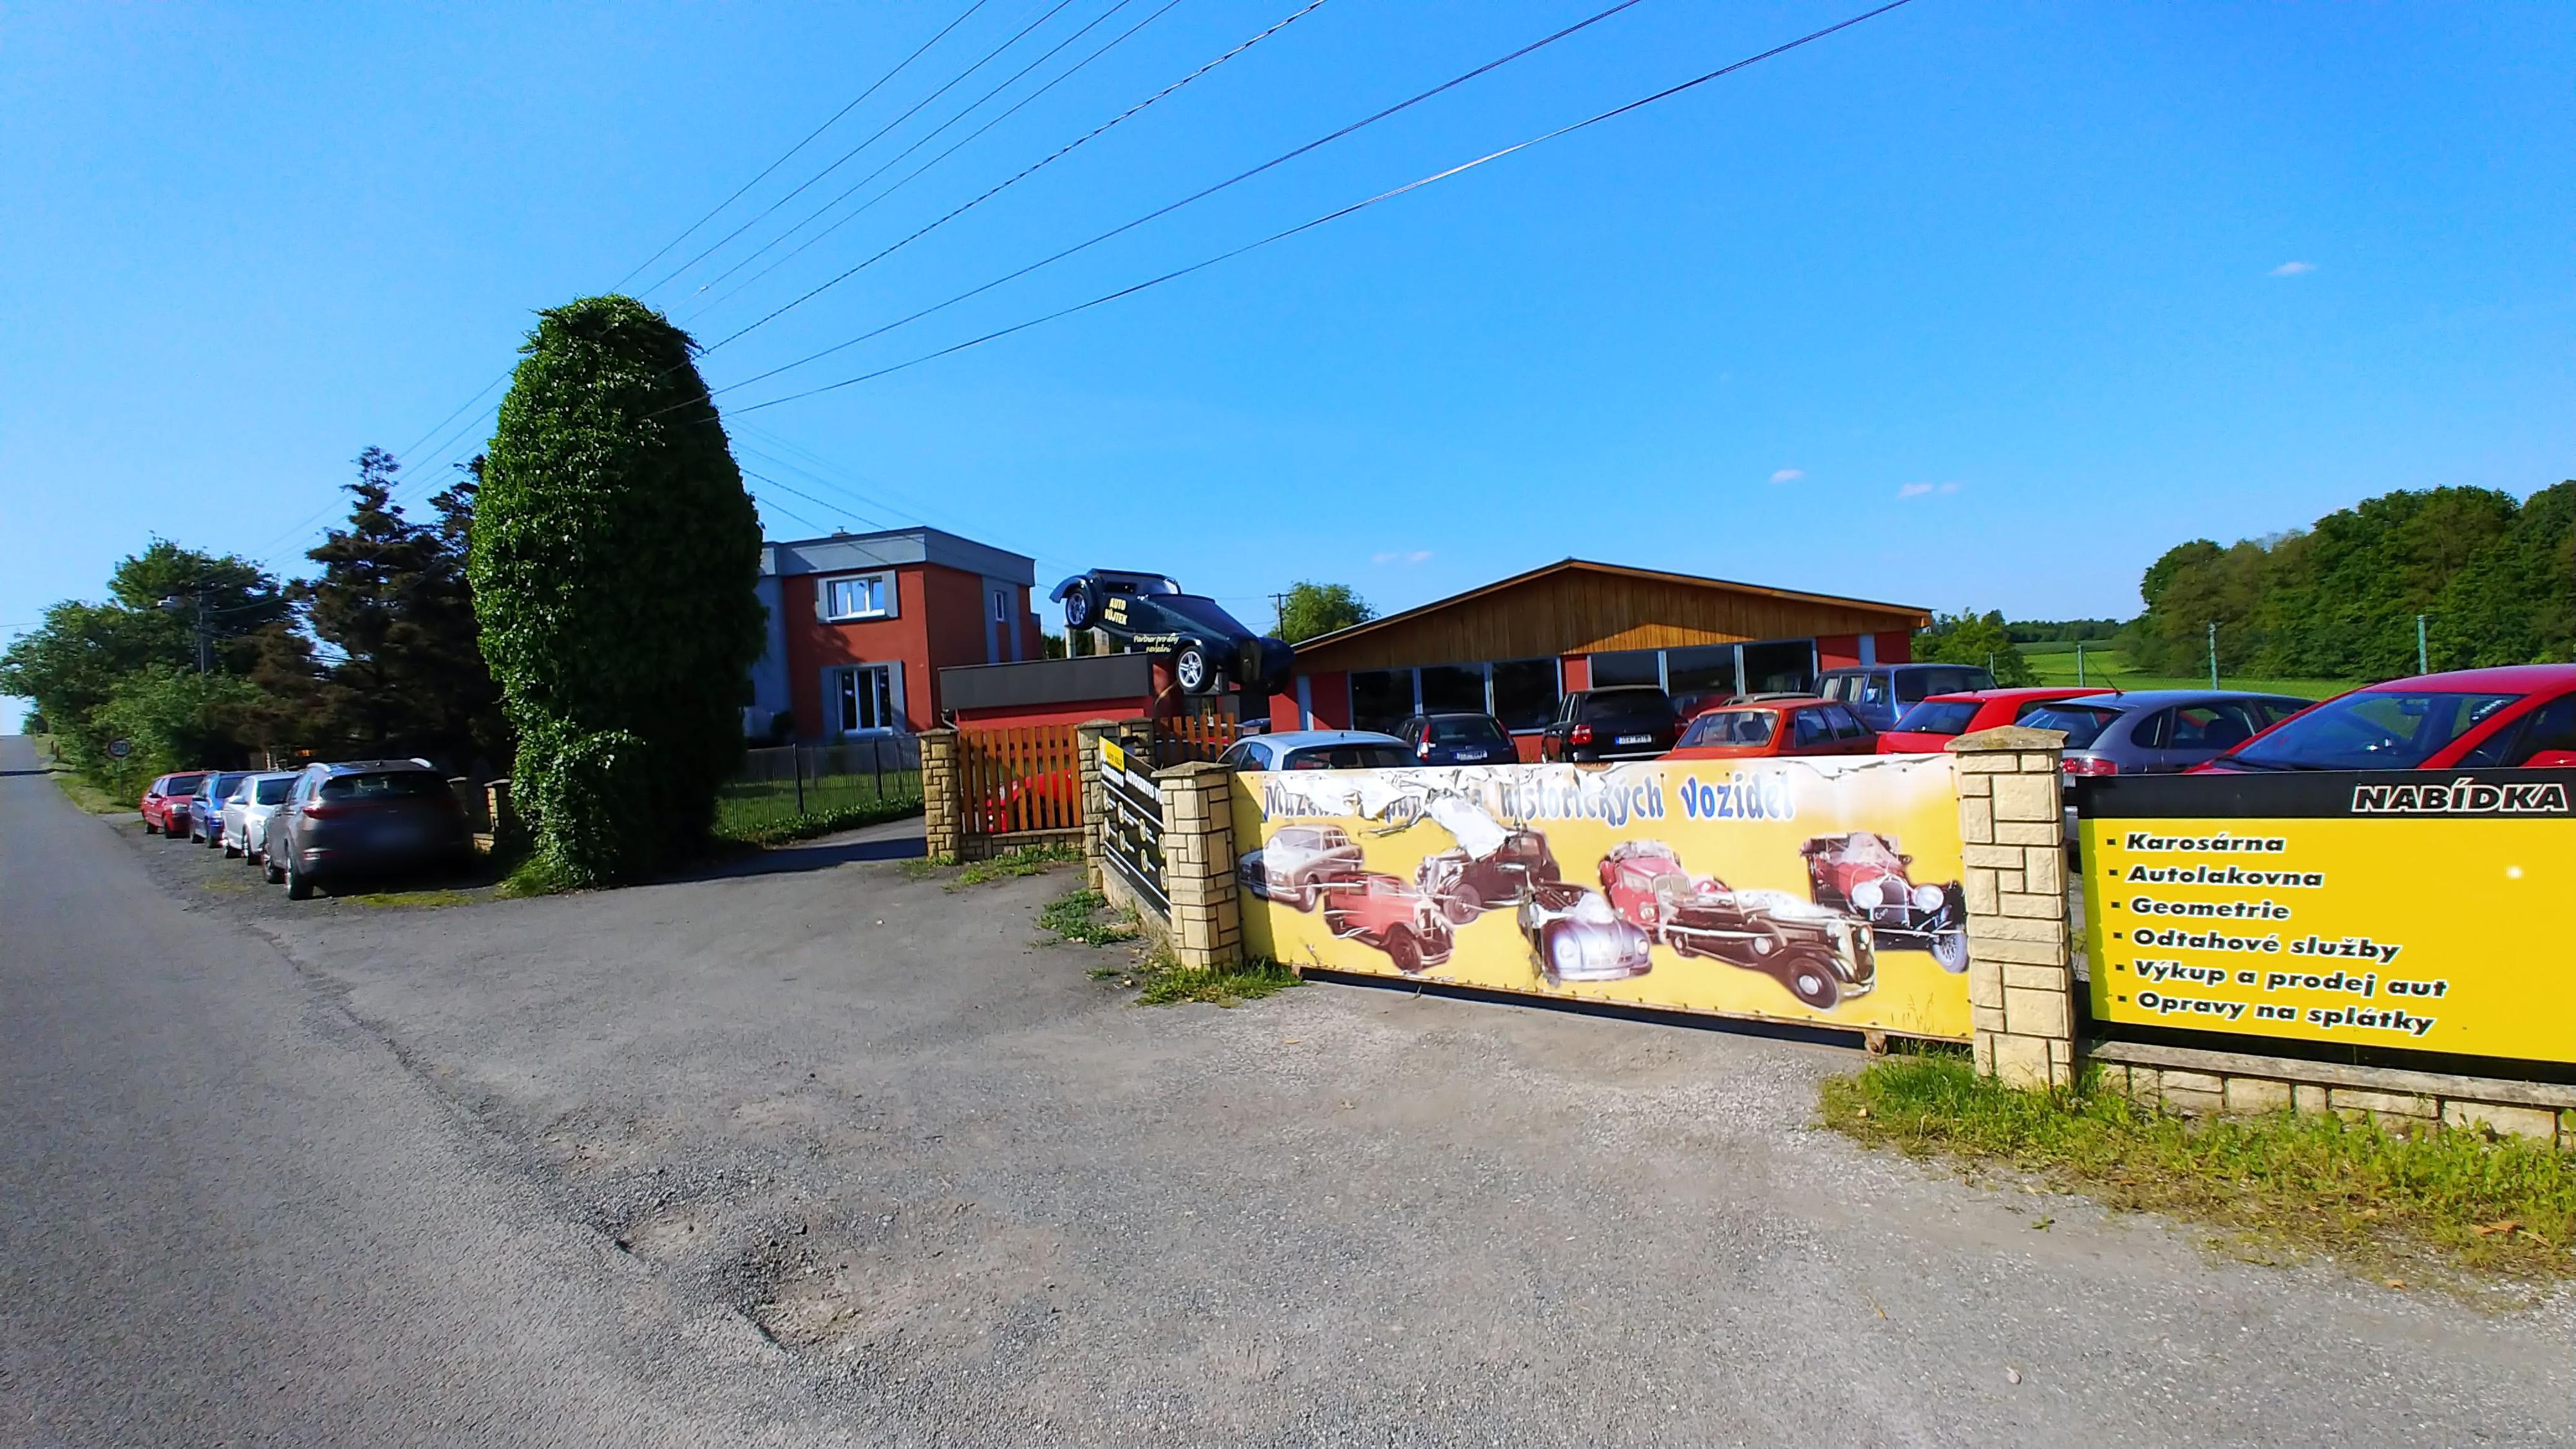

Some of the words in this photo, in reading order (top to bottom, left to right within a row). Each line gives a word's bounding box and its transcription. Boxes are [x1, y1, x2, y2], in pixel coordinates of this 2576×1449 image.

[1109, 598, 1126, 611] AUTO
[1156, 636, 1167, 645] pro
[1680, 773, 1794, 819] Vozidel
[2351, 777, 2568, 813] NABÍDKA
[2125, 832, 2286, 852] Karosárna
[2126, 865, 2324, 887] Autolakovna
[2131, 897, 2291, 920] Geometrie
[2133, 928, 2280, 953] Odtahové
[2289, 936, 2401, 964] služby
[2135, 959, 2226, 986] Výkup
[2237, 971, 2257, 985] a
[2266, 971, 2377, 998] prodej
[2387, 980, 2448, 998] aut
[2137, 990, 2246, 1021] Opravy
[2255, 1003, 2297, 1021] na
[2306, 1005, 2436, 1037] splátky
